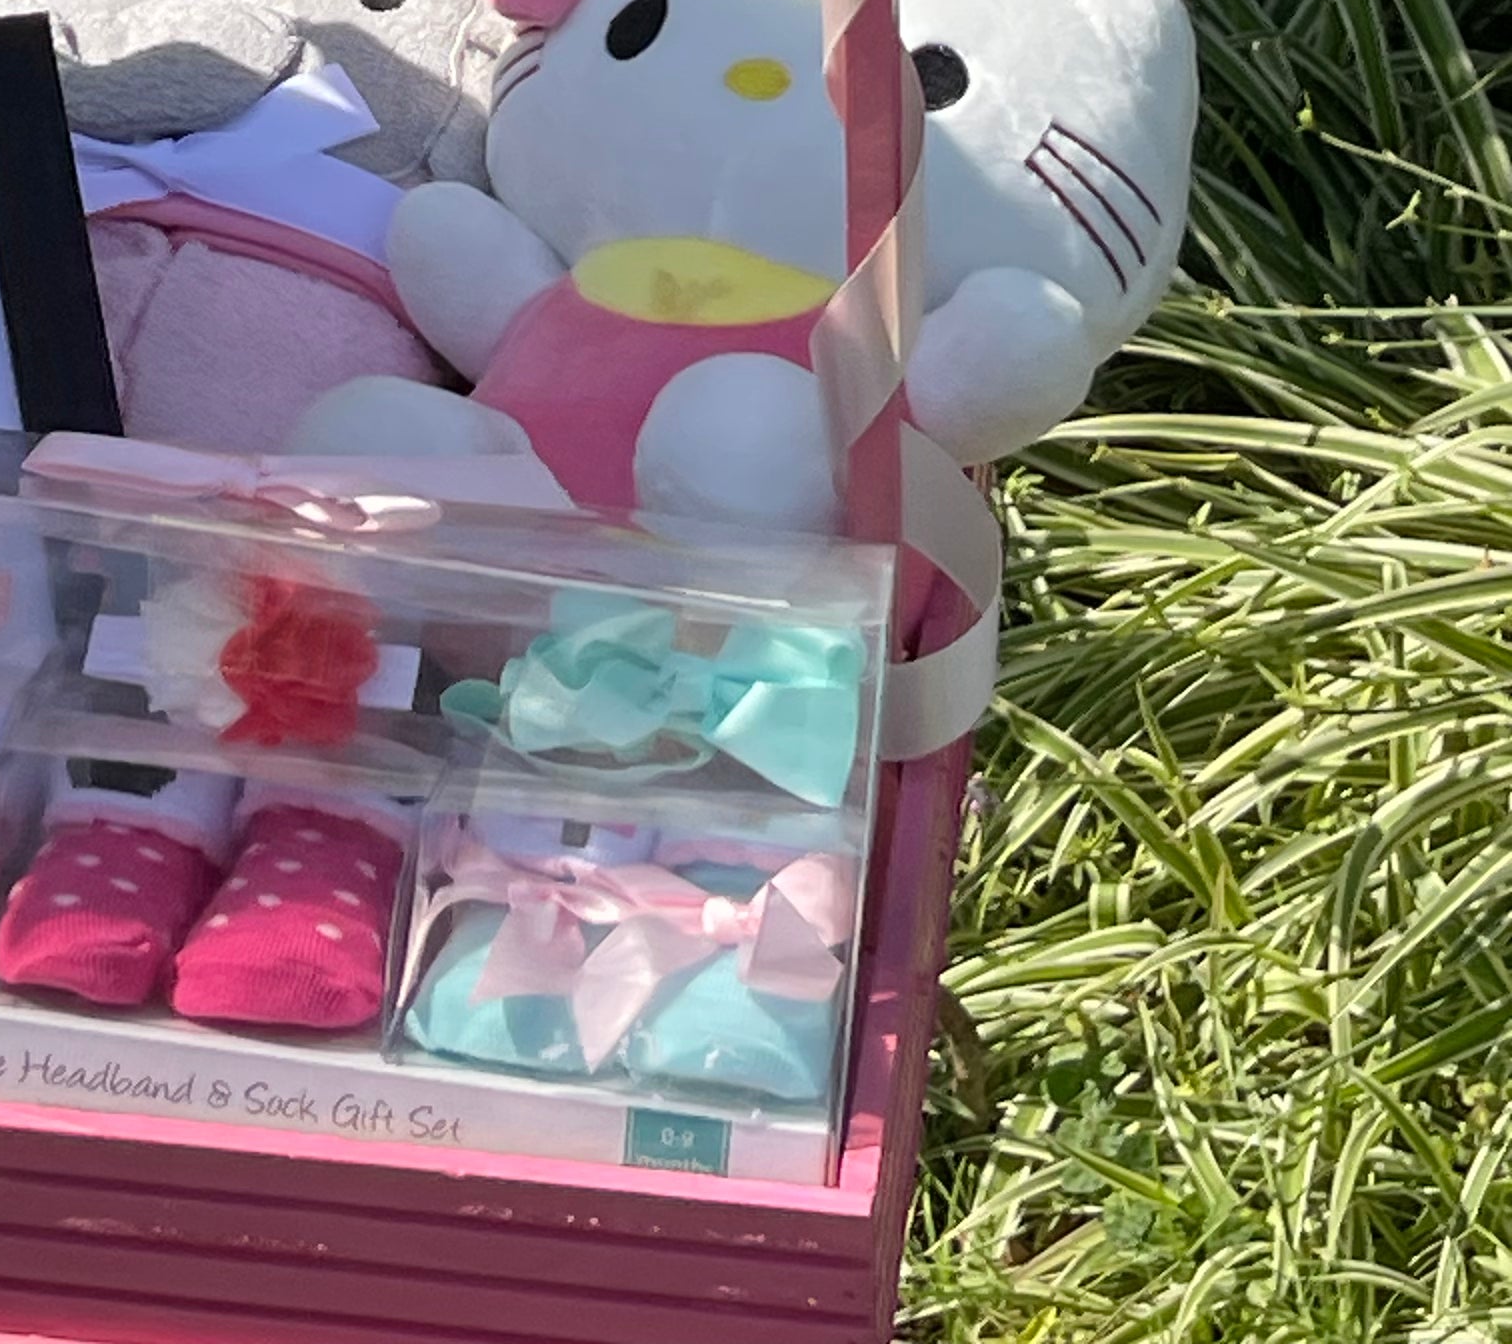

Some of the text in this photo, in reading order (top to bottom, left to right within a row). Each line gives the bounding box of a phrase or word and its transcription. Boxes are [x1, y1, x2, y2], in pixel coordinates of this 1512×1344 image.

[17, 1050, 197, 1104] Headband
[244, 1081, 319, 1124] Sock
[332, 1093, 393, 1133] Gift
[408, 1106, 461, 1143] Set
